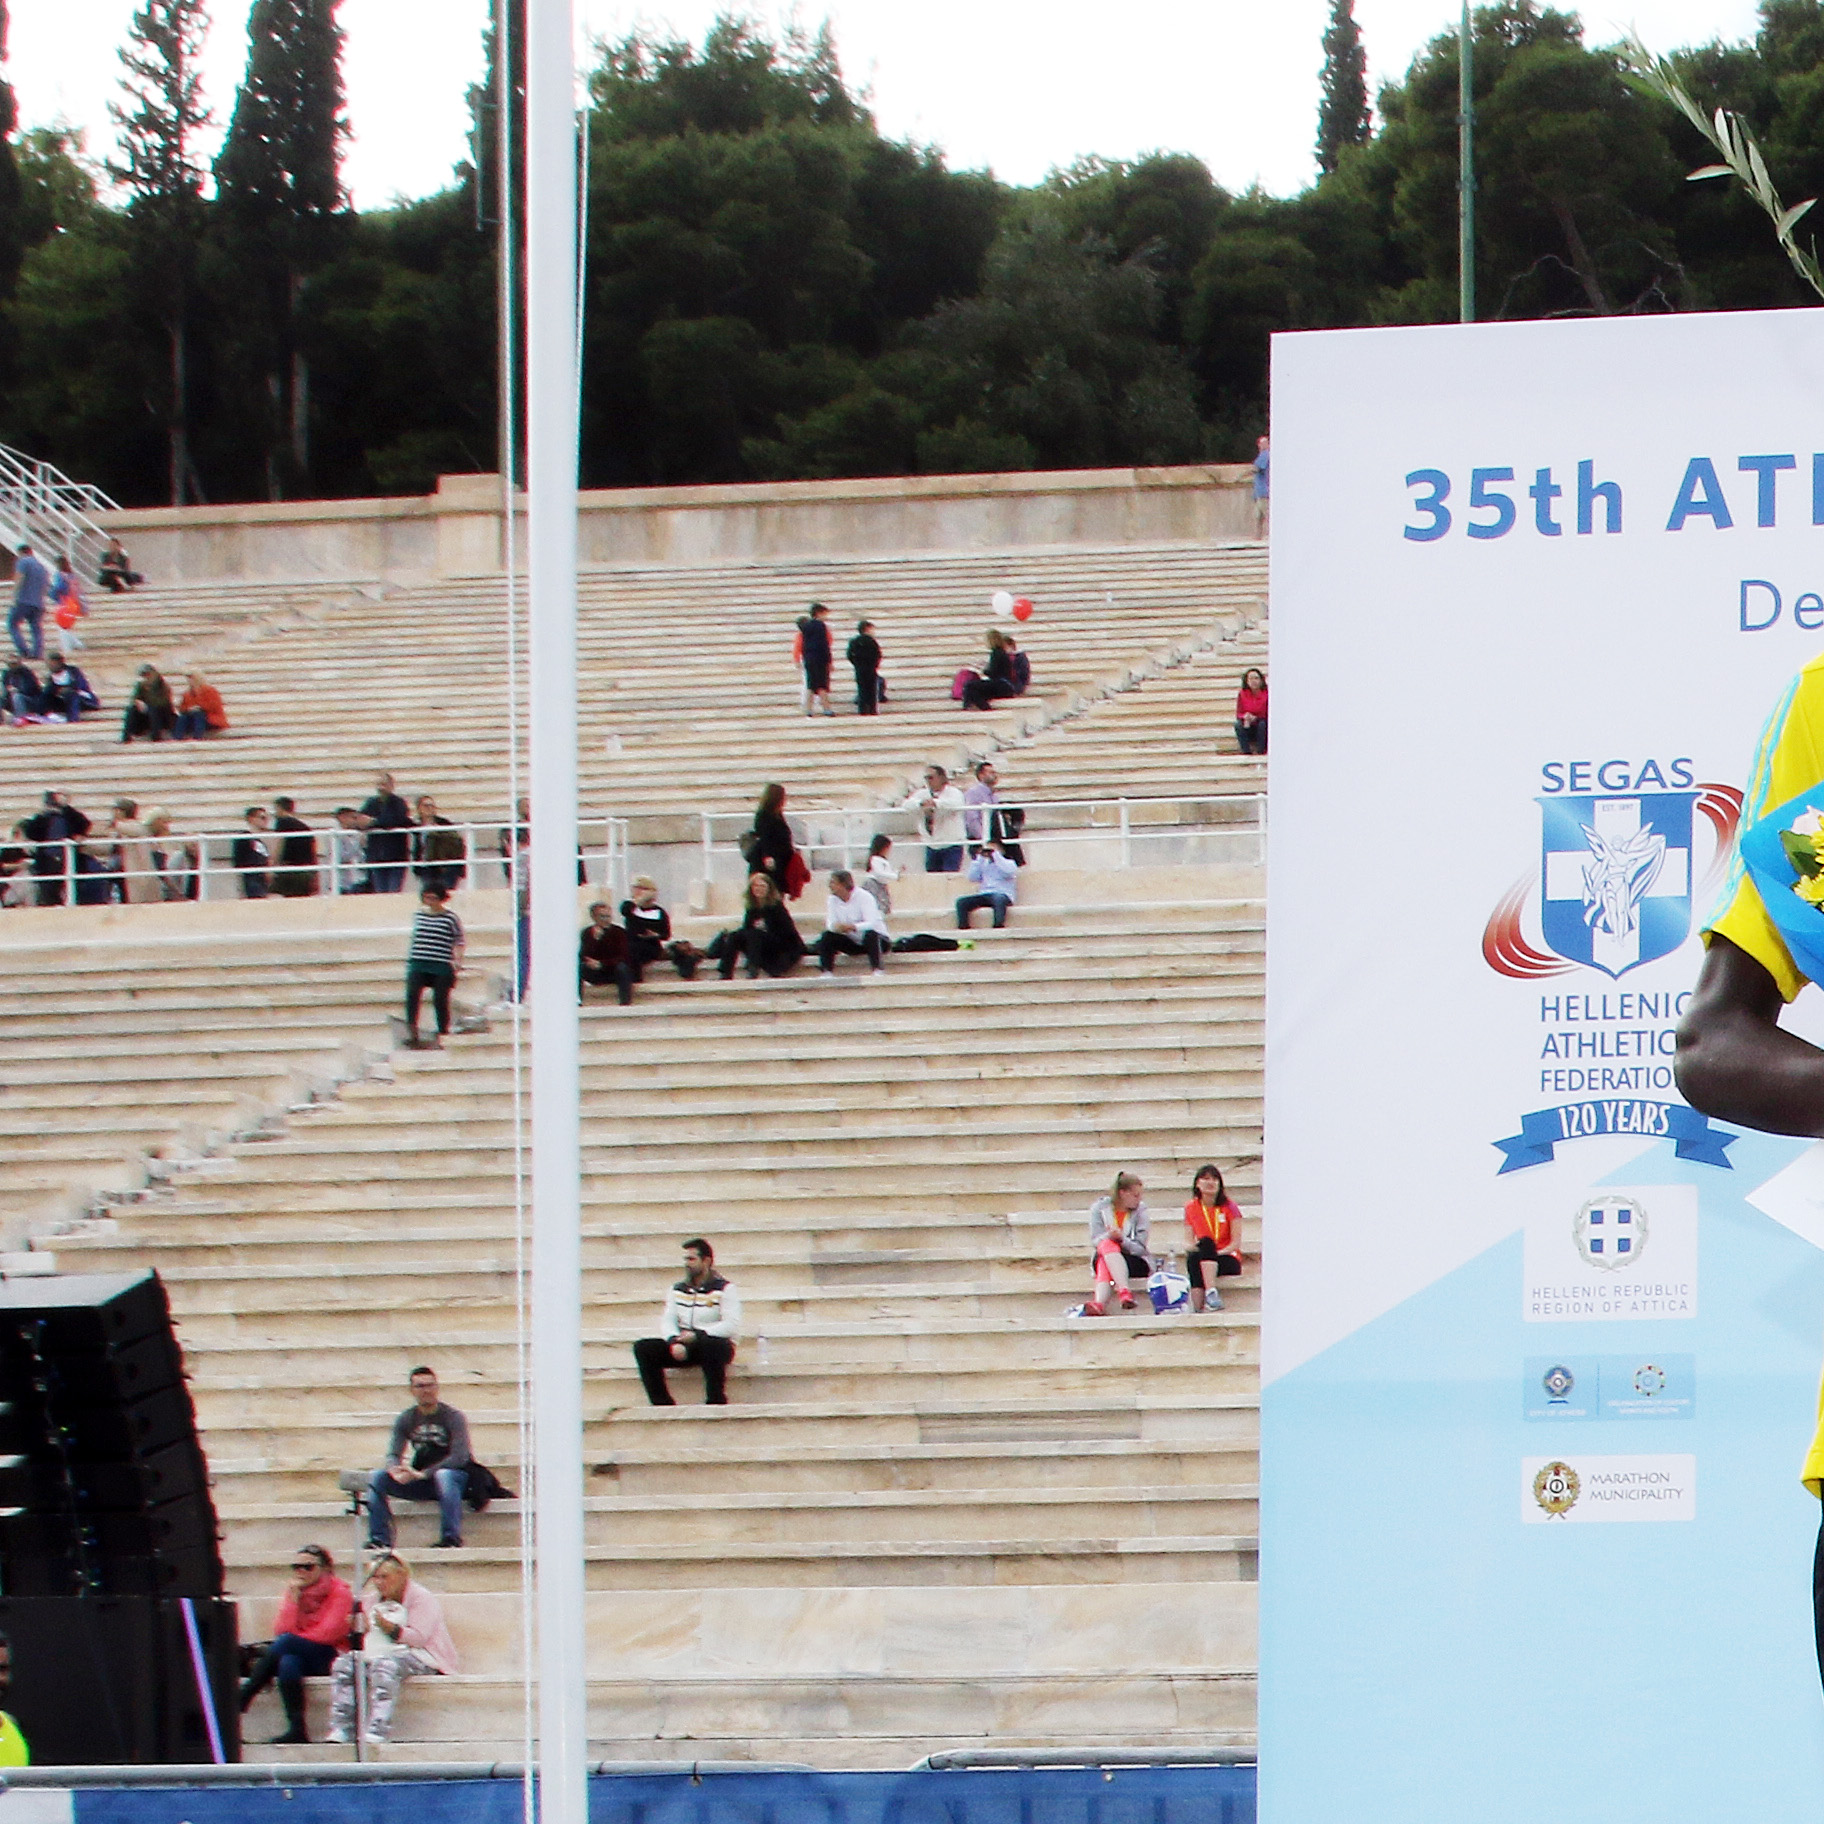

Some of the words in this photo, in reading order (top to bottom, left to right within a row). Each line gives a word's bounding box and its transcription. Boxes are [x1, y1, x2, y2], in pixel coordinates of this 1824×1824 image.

[1403, 458, 1622, 542] 35th
[1542, 758, 1694, 793] SEGAS
[1541, 1029, 1677, 1059] ATHLETIC
[1541, 1066, 1677, 1092] FEDERATIO
[1557, 1104, 1597, 1139] 120
[1603, 1101, 1671, 1137] YEARS
[1532, 1286, 1607, 1299] HELLENIC
[1614, 1284, 1688, 1297] REPUBLIC
[1532, 1302, 1594, 1314] REGION
[1603, 1301, 1621, 1313] OF
[1631, 1300, 1688, 1312] ATTICA
[1589, 1472, 1670, 1485] MARATHON
[1589, 1488, 1684, 1501] MUNICIPALITY
